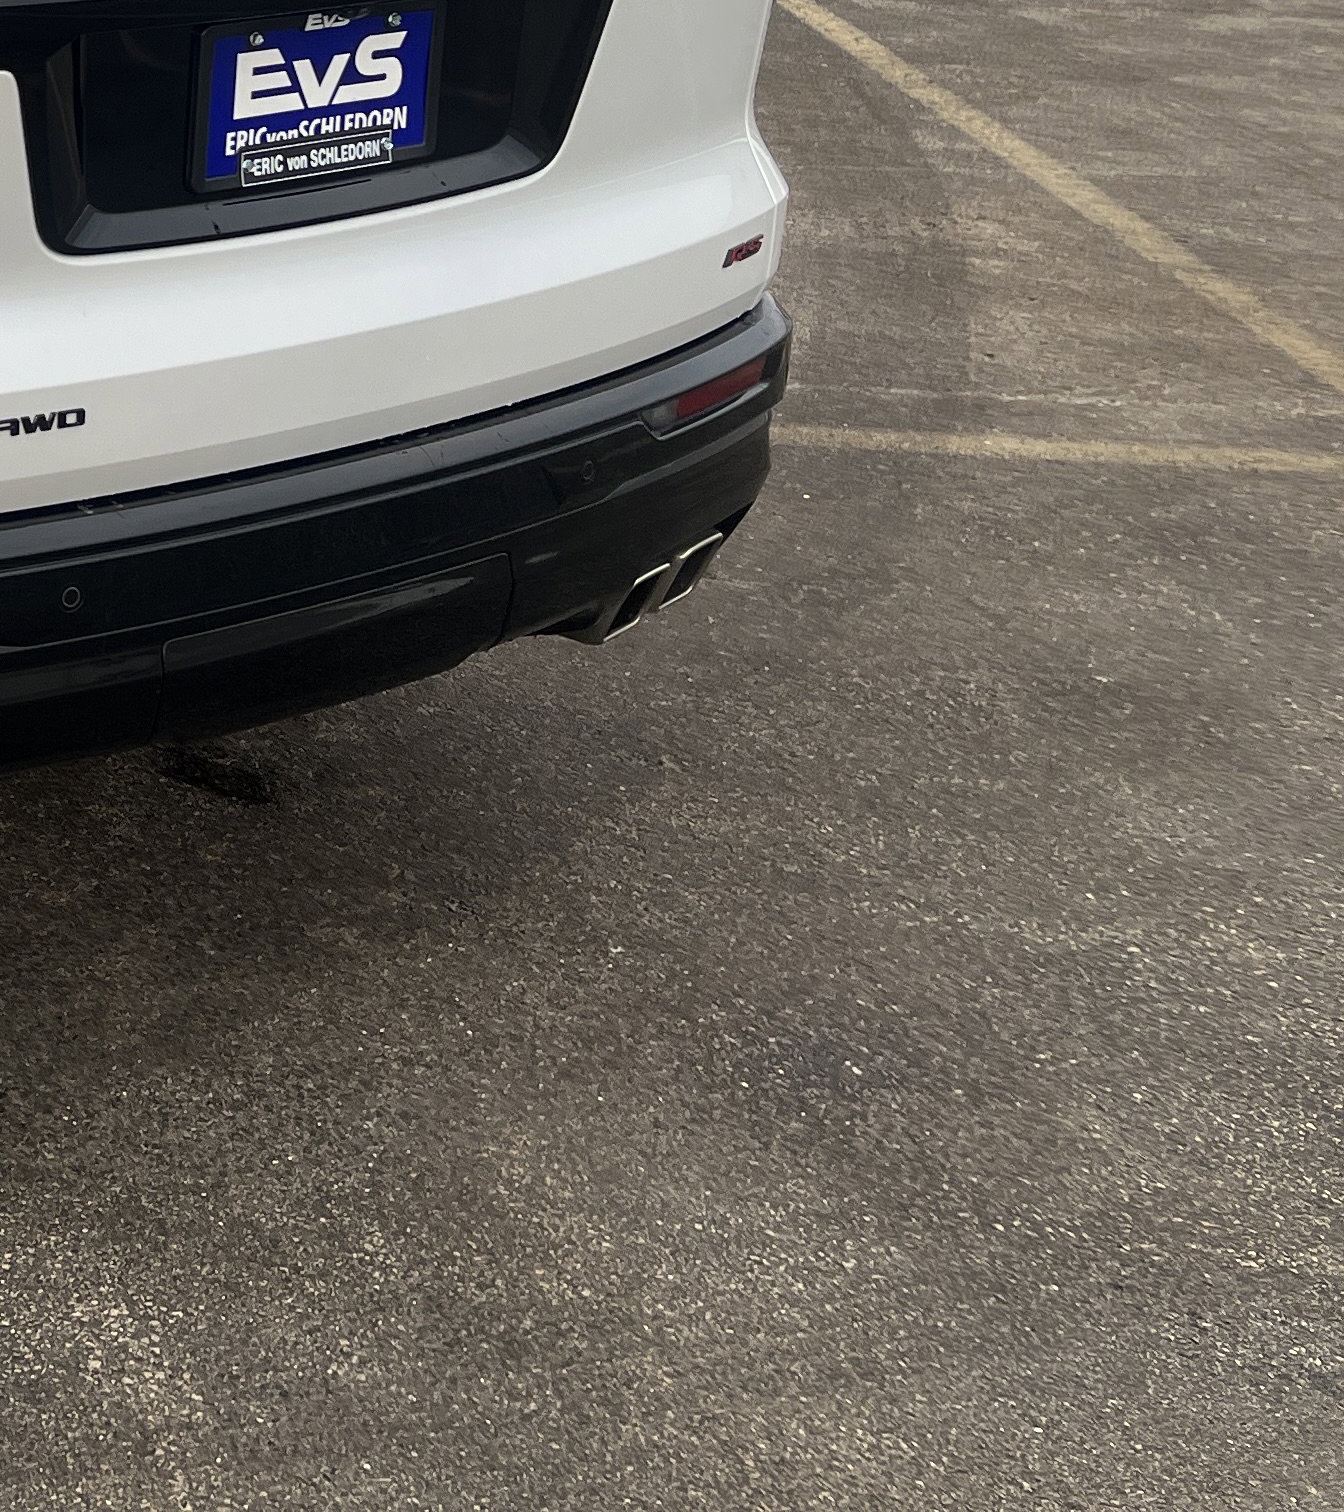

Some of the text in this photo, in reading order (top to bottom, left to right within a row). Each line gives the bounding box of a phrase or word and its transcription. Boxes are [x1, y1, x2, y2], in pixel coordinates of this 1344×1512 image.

[252, 139, 382, 177] ERIC von SCHLEDORN
